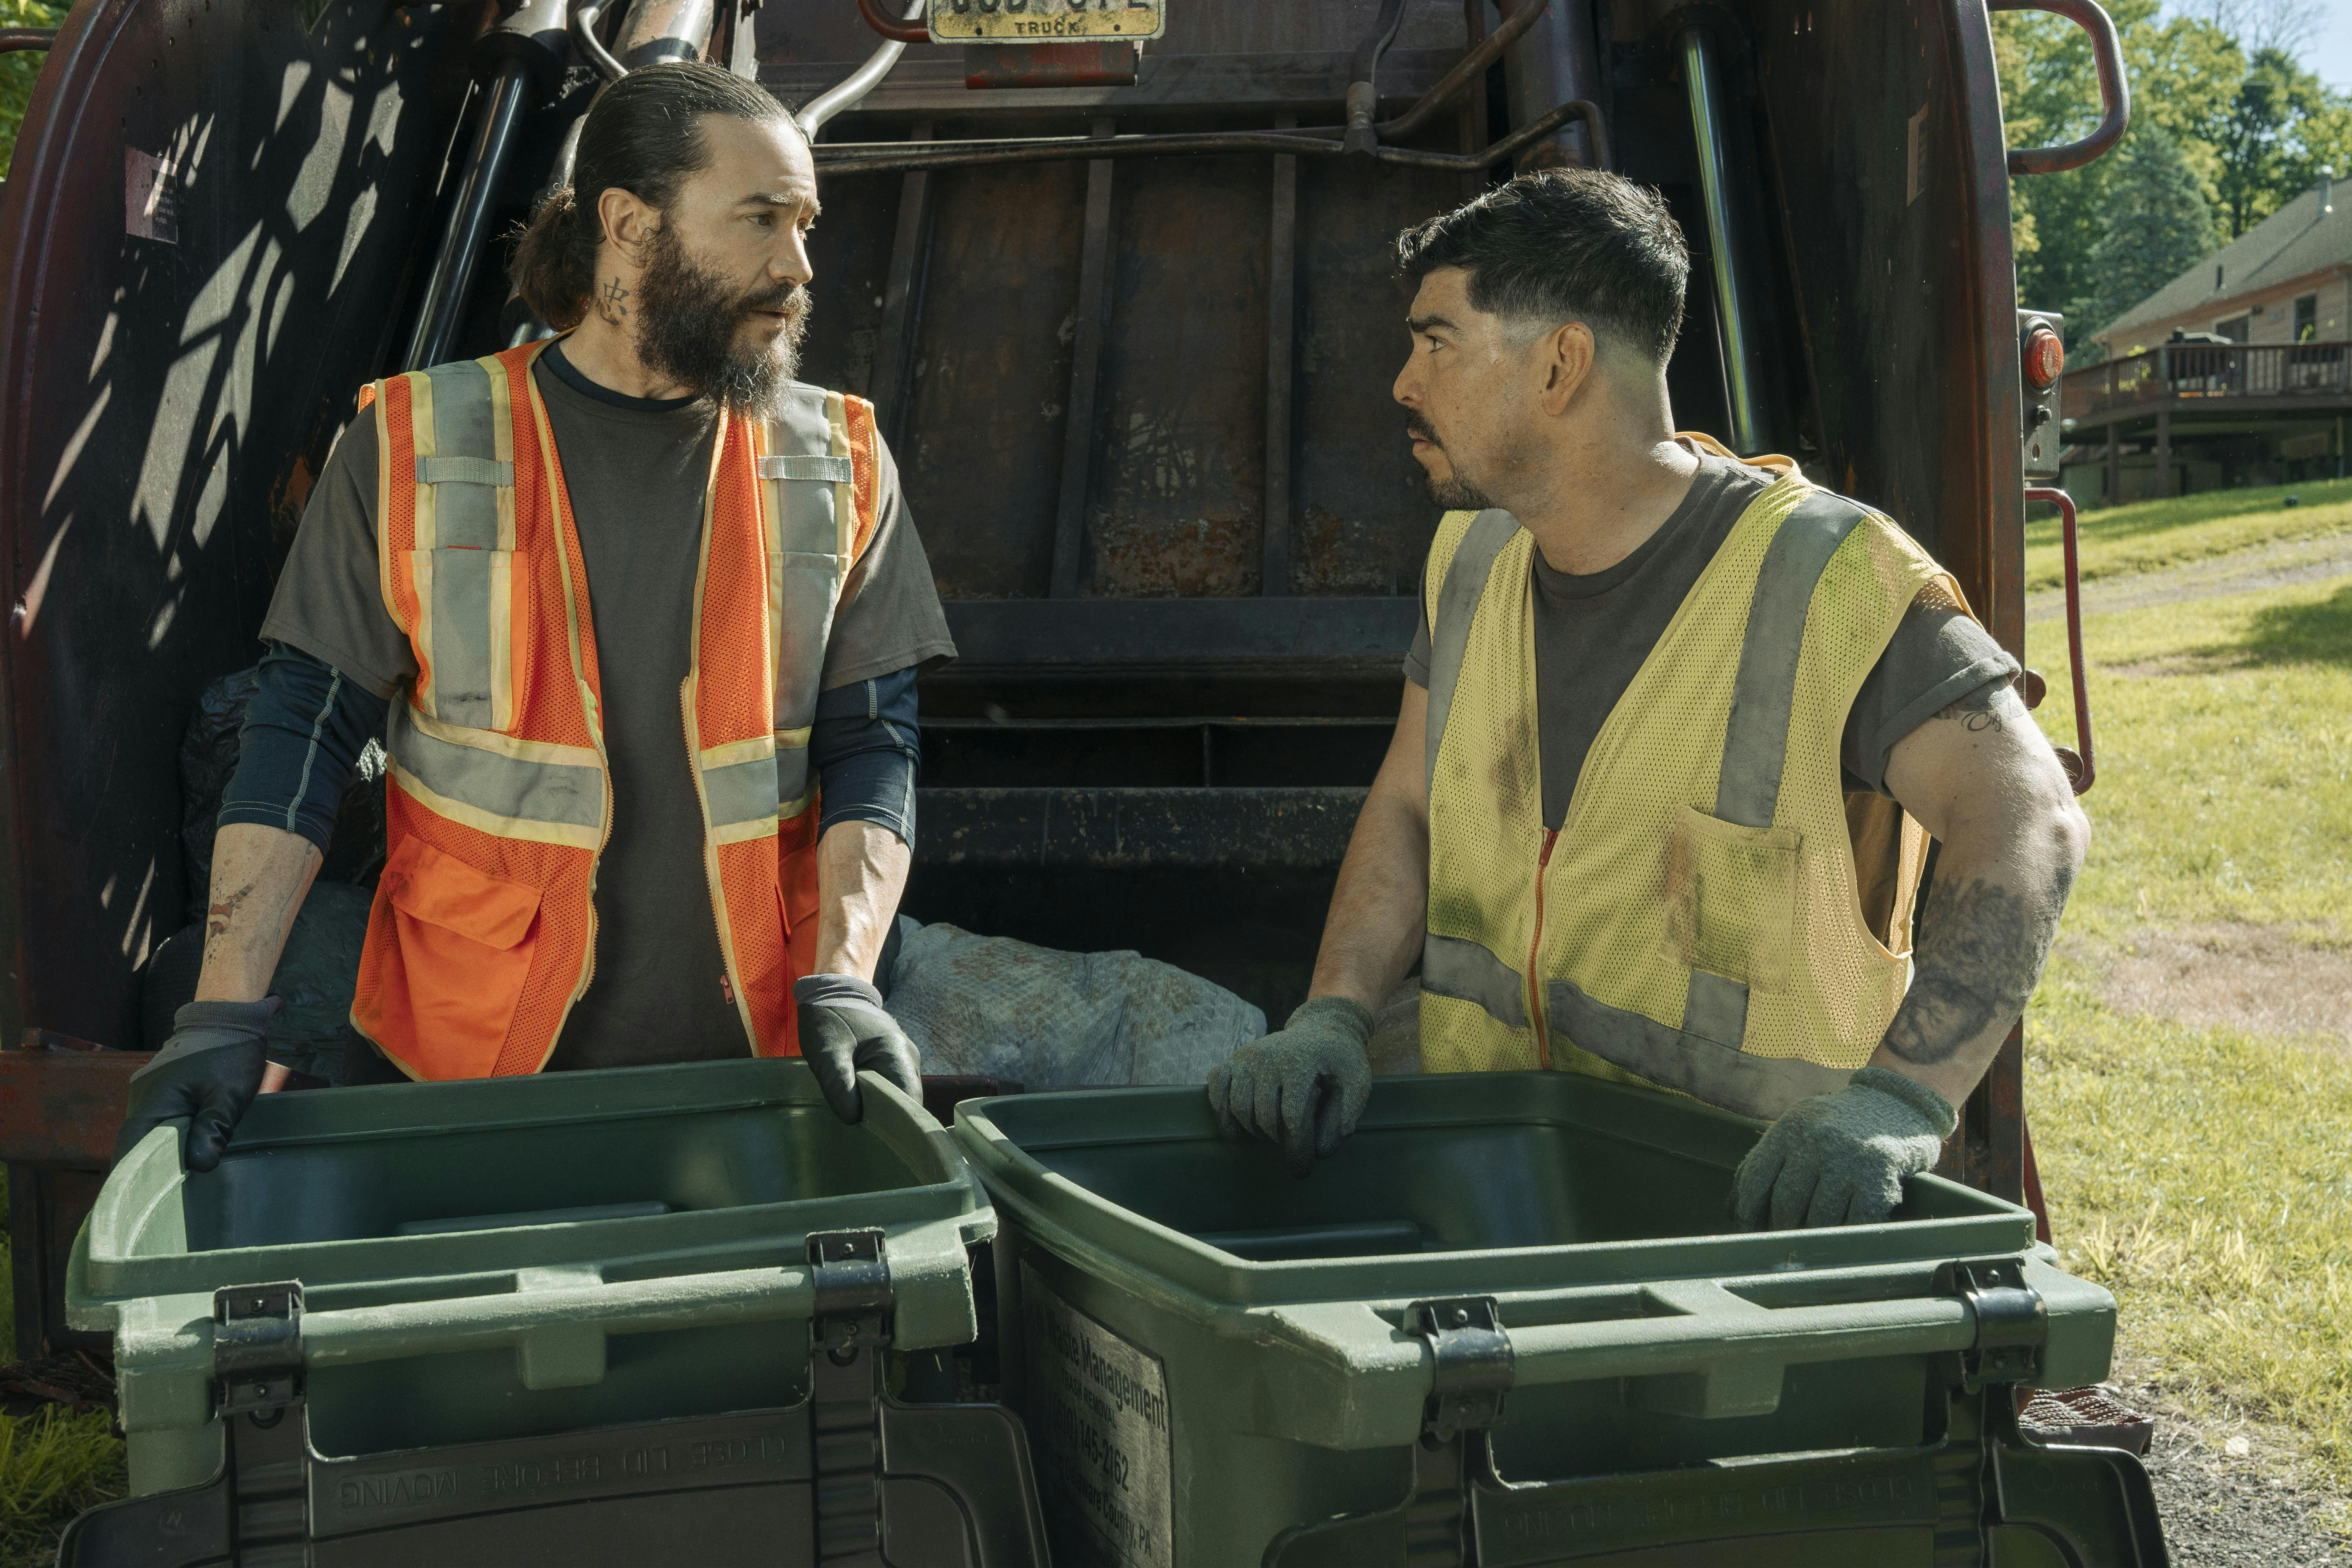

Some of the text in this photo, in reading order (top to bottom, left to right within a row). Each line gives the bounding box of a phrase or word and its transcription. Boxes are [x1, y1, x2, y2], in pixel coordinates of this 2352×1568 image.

[1015, 21, 1079, 34] TRUCK
[1045, 1305, 1080, 1367] Waste
[1080, 1332, 1166, 1433] Management
[1061, 1368, 1117, 1430] TRASH REMOVAL
[340, 1432, 785, 1509] CLOSE LID BEFORE MOVING
[1080, 1418, 1129, 1493] 145-2162
[1065, 1456, 1102, 1511] Delaware
[1103, 1492, 1136, 1548] County,
[1139, 1524, 1152, 1557] PA
